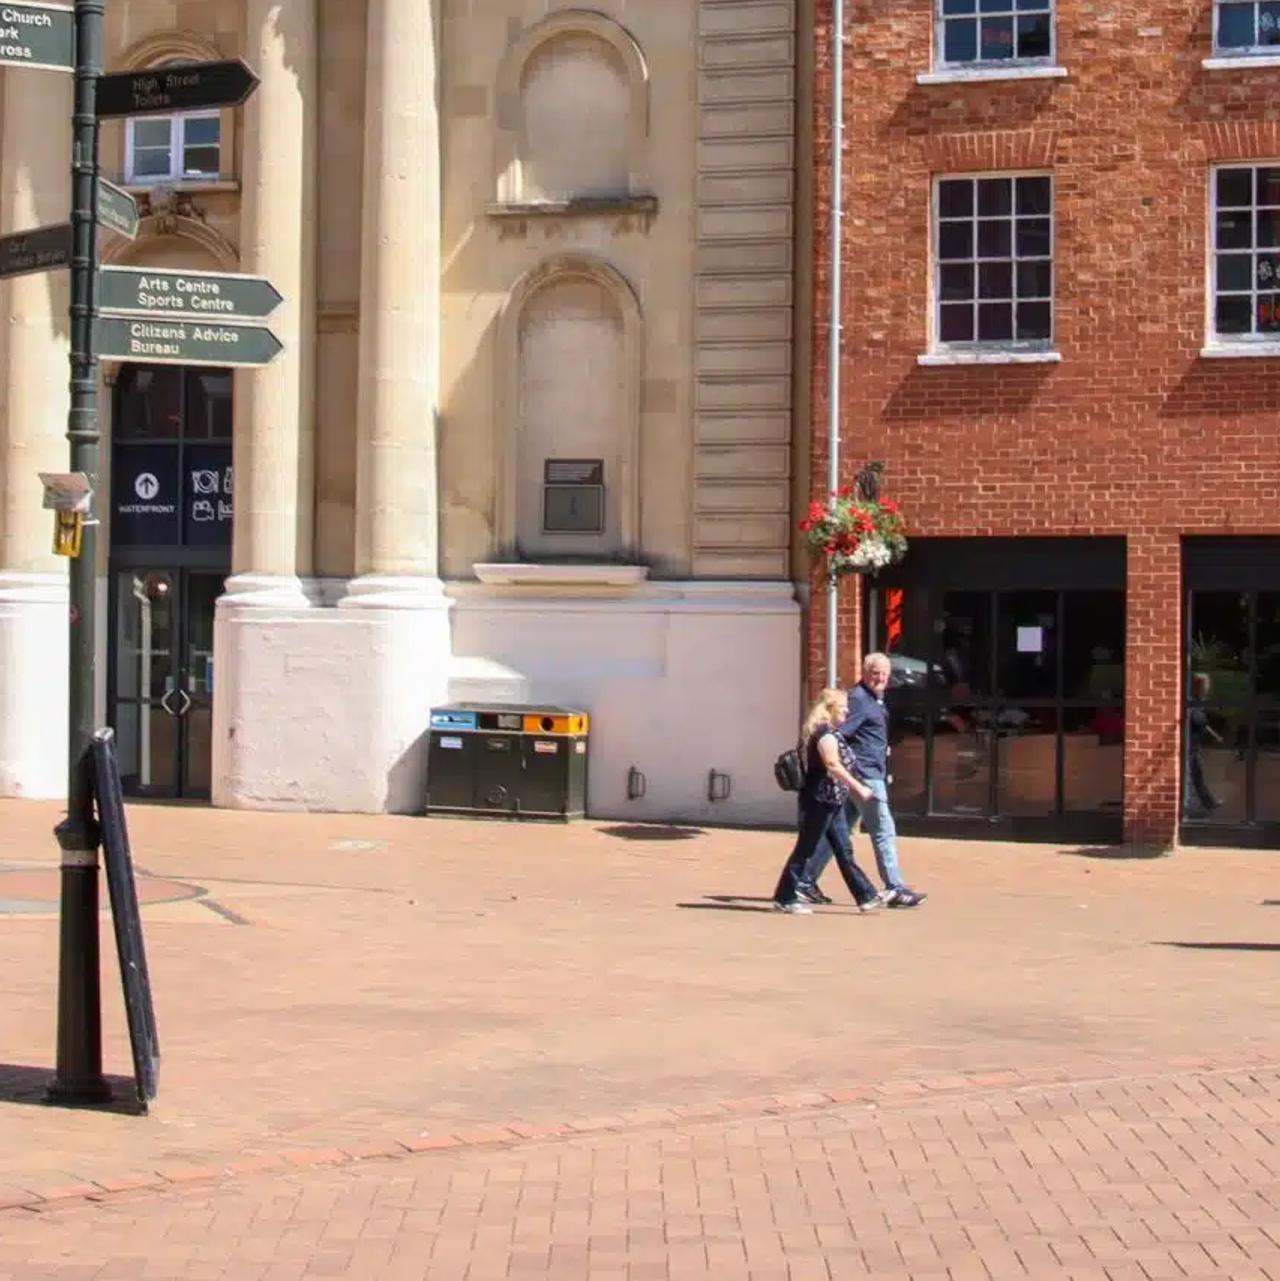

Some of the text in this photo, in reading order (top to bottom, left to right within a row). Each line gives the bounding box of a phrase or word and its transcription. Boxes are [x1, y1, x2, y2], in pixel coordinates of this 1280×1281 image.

[2, 8, 52, 28] Church
[138, 276, 220, 294] Arts Centre
[137, 292, 235, 311] Sports Centre
[192, 327, 239, 342] Advice
[131, 339, 180, 355] Bureau
